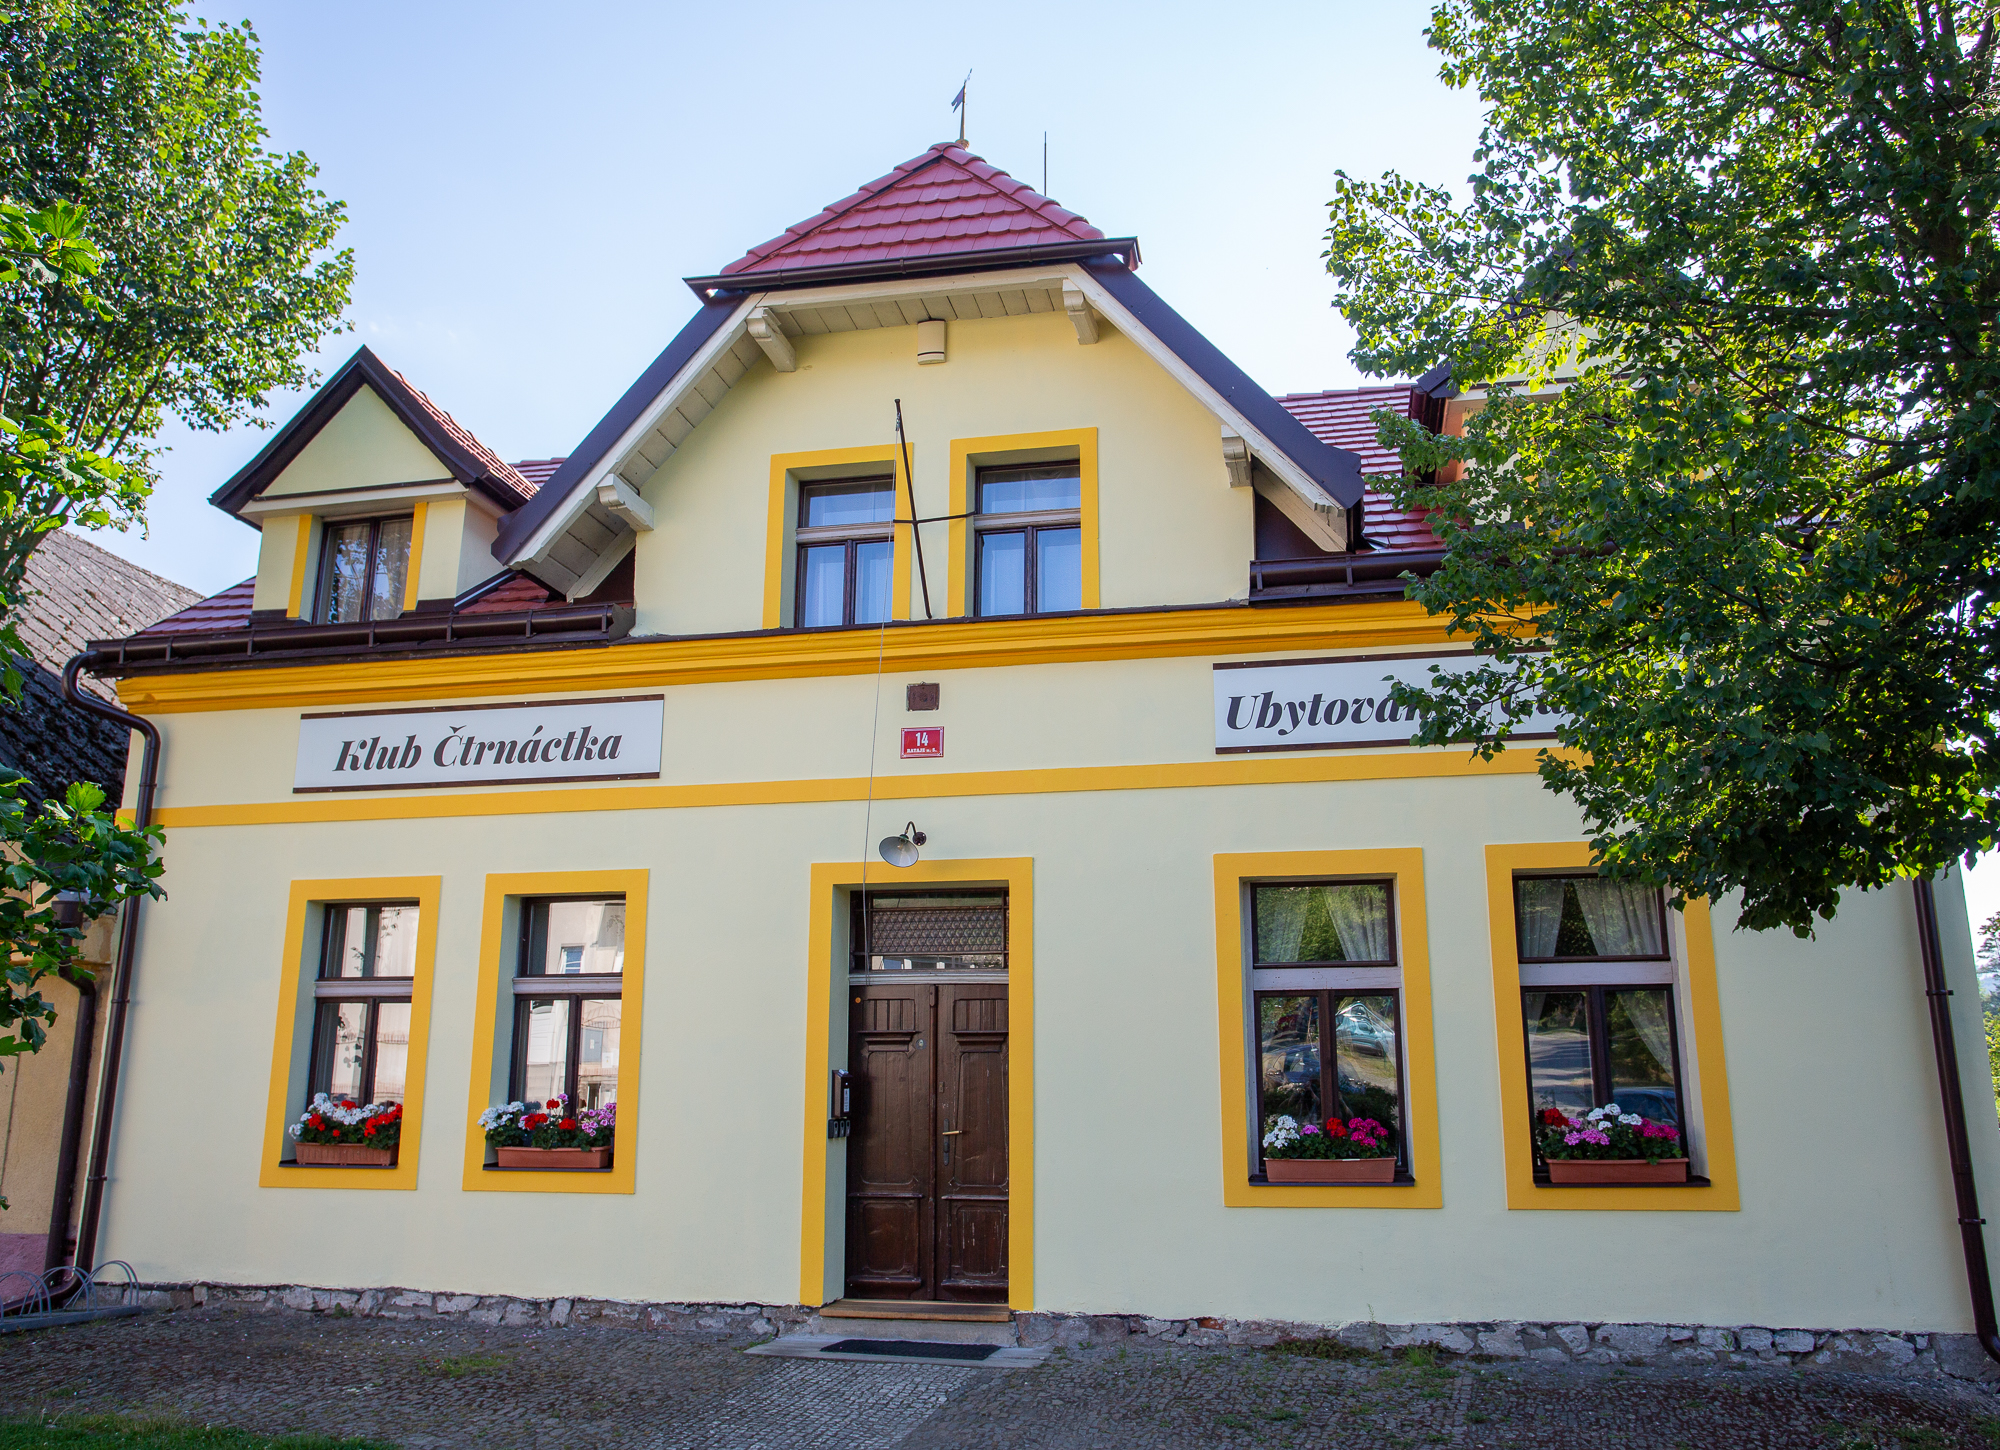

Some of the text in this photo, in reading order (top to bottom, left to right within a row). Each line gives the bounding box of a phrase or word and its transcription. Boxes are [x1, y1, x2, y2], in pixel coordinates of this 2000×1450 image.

[332, 725, 622, 772] Klub Čtrnáctka
[915, 732, 928, 746] 14
